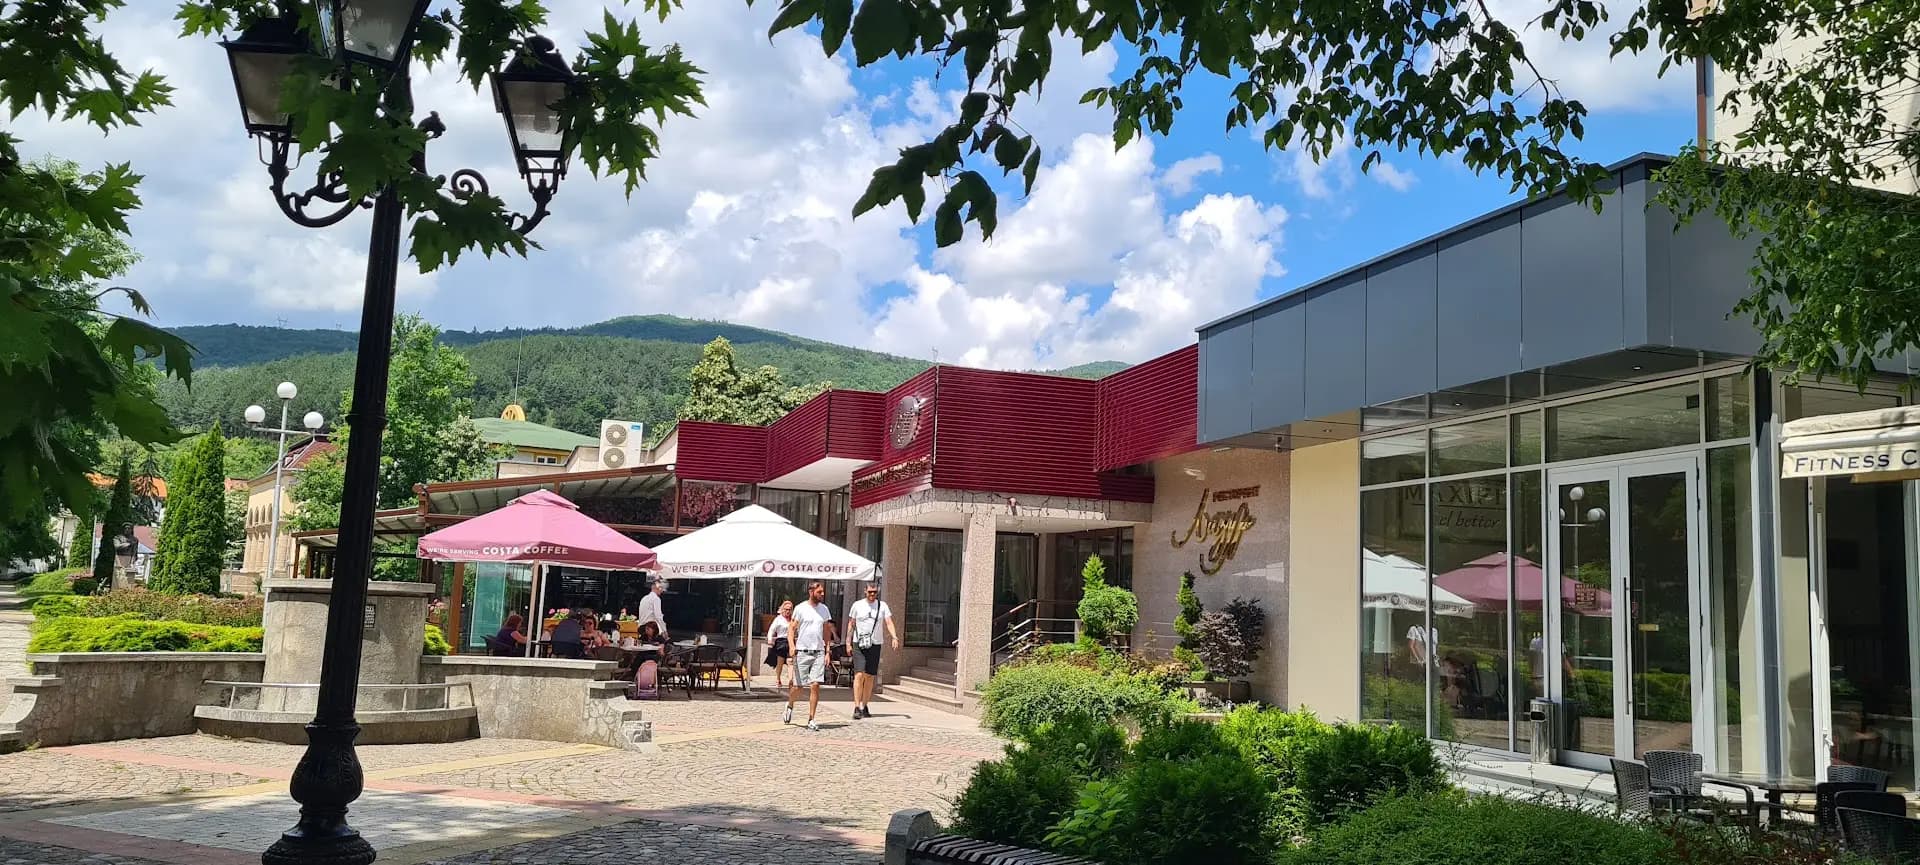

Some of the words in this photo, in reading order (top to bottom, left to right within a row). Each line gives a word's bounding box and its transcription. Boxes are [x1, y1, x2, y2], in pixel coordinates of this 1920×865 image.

[1794, 454, 1890, 473] FITNESS
[482, 546, 520, 556] COSTA
[523, 545, 569, 555] COFFEE
[671, 564, 705, 574] WE'RE
[708, 563, 755, 573] SERVING
[780, 563, 813, 573] COSTA
[817, 564, 859, 574] COFFEE
